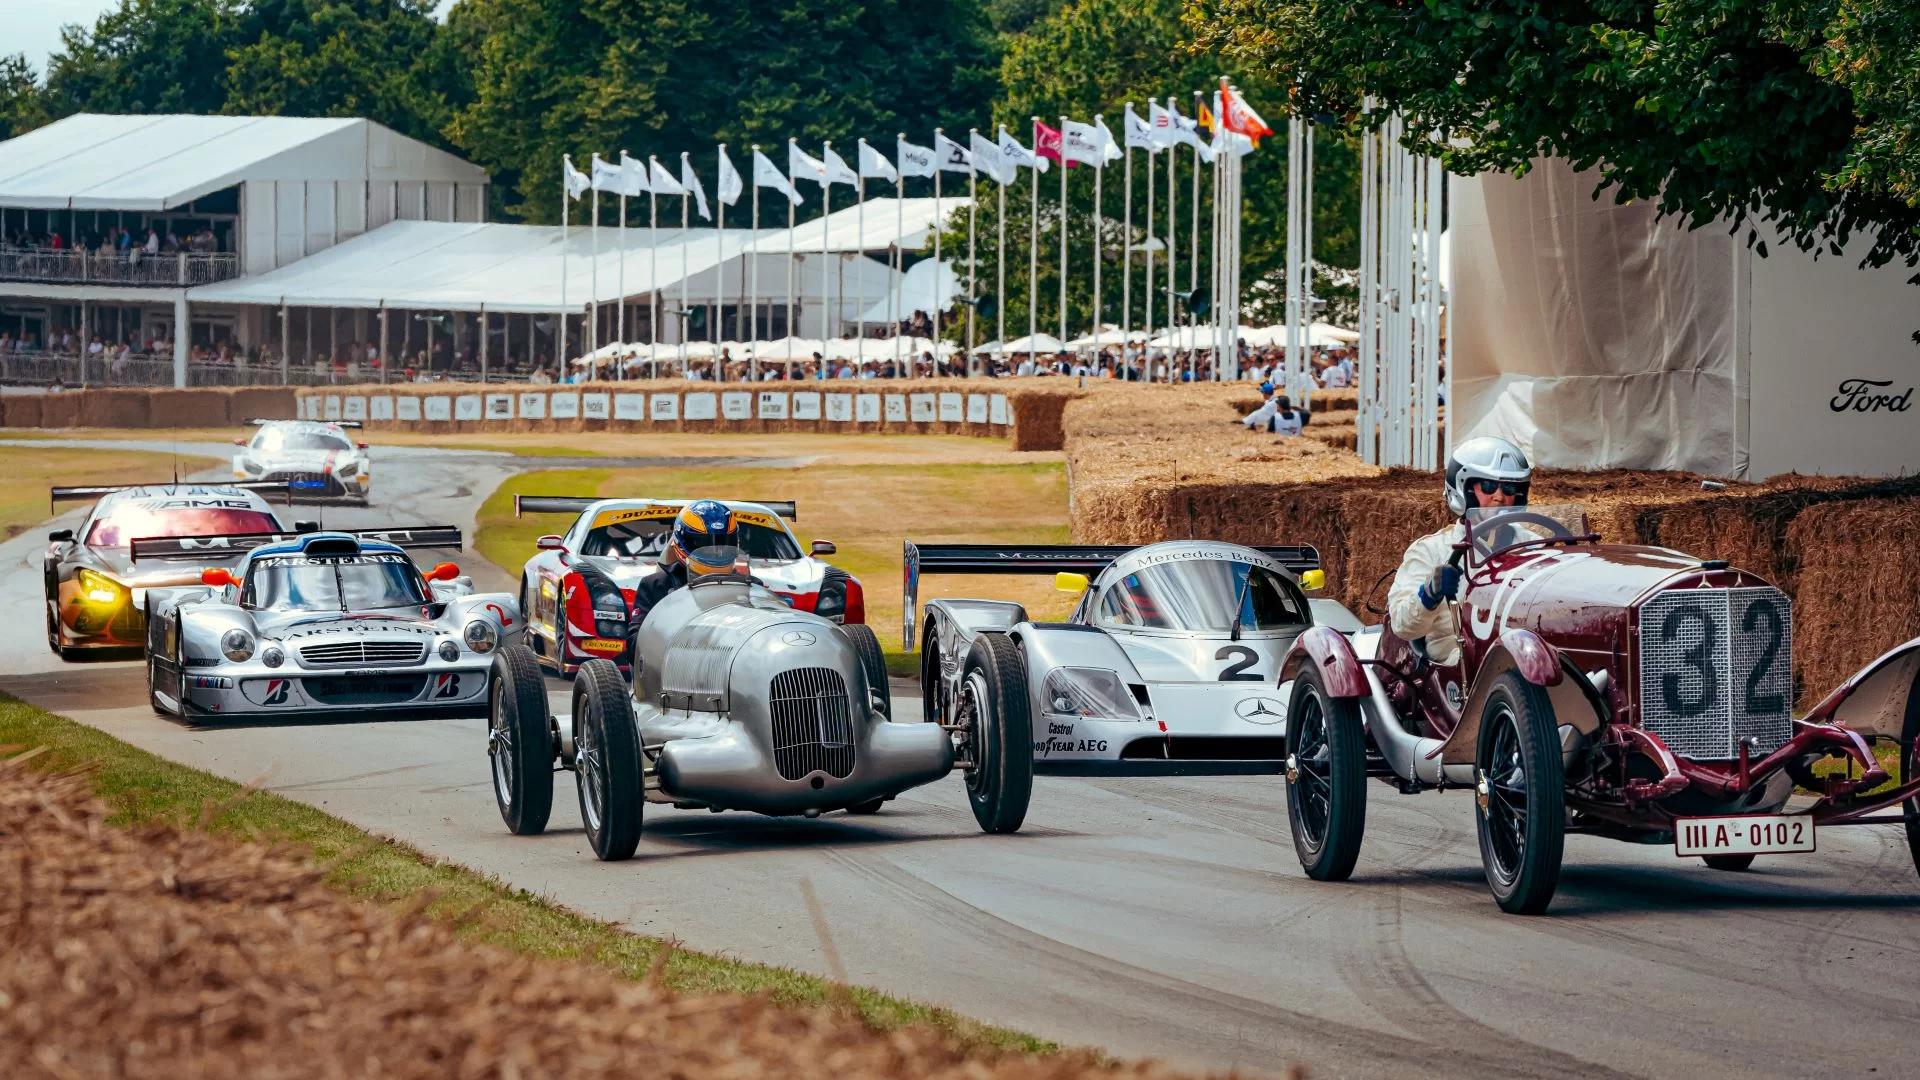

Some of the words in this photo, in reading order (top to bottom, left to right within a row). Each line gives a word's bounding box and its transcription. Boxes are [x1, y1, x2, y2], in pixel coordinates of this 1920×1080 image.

[1829, 378, 1914, 412] Ford
[160, 499, 251, 509] AMG
[259, 554, 407, 568] WARSTEINER
[1137, 550, 1275, 569] Mercedes-Benz
[588, 641, 621, 649] DUNLOP
[1214, 645, 1264, 681] 2
[1661, 599, 1785, 718] 32
[1048, 722, 1075, 735] Castrol
[1077, 739, 1108, 752] AEG
